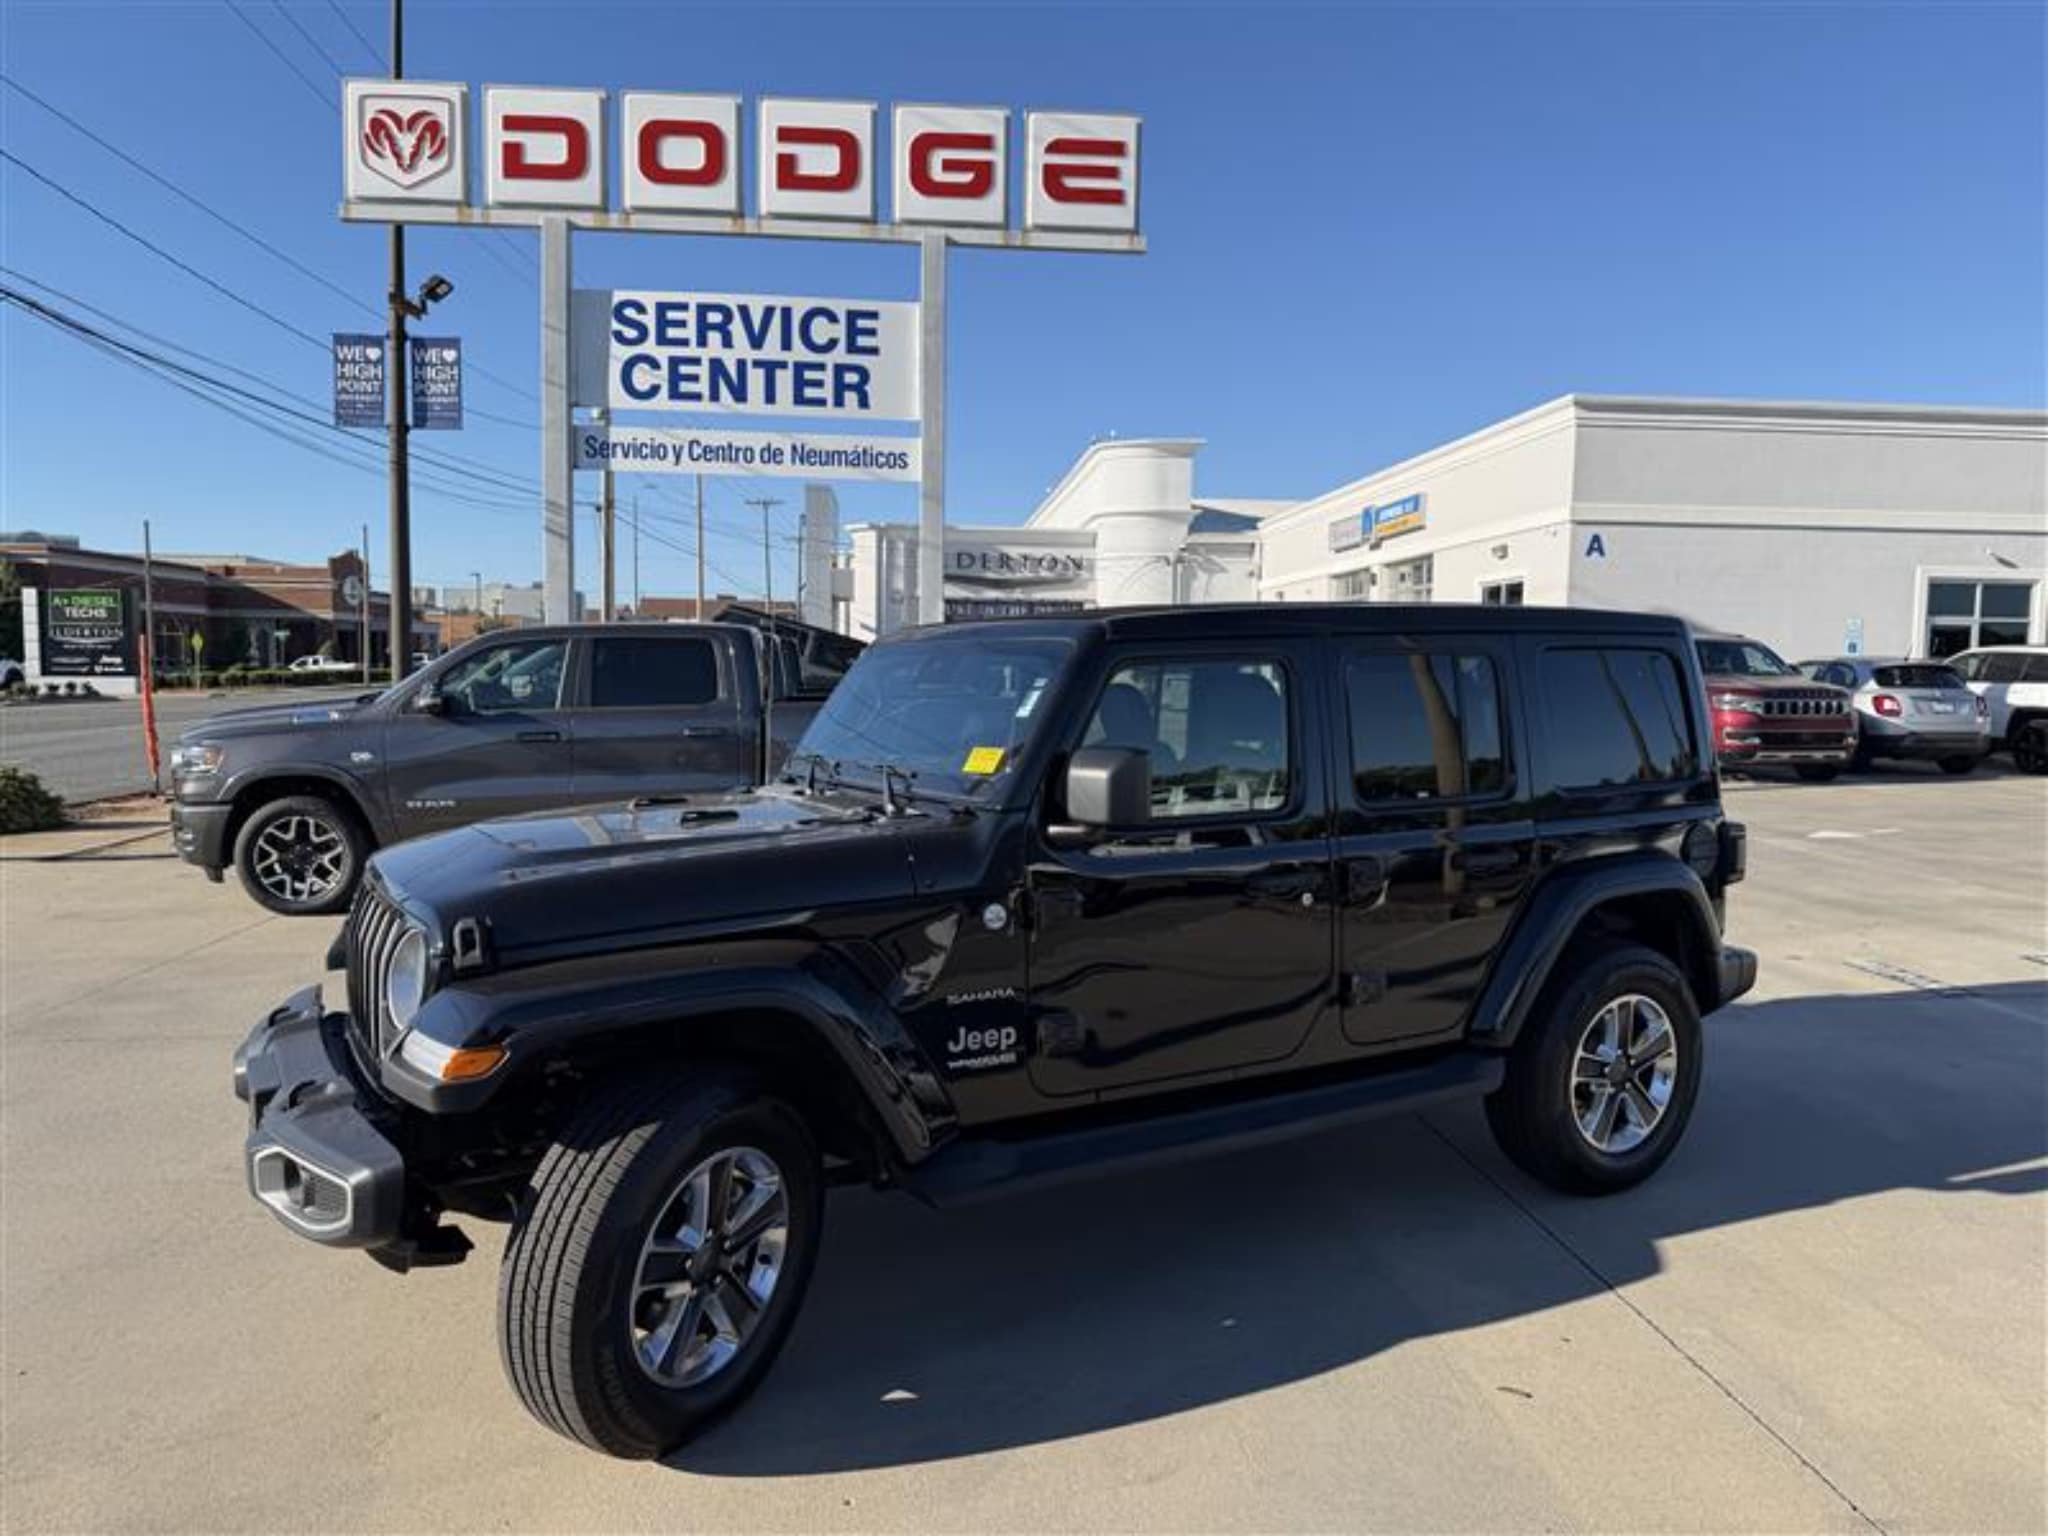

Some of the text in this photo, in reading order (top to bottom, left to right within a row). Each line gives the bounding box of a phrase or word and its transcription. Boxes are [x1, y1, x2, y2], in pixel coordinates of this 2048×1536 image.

[502, 114, 1127, 205] DODGE
[611, 299, 881, 356] SERVICE
[336, 345, 364, 361] WE
[414, 347, 440, 363] WE
[336, 362, 382, 379] HIGH
[414, 364, 459, 380] HIGH
[337, 379, 380, 393] POINT
[414, 381, 458, 395] POINT
[620, 354, 871, 410] CENTER
[585, 435, 908, 470] Servicio y Centro de Neumáticos
[1585, 533, 1606, 557] A
[948, 1026, 1017, 1053] Jeep
